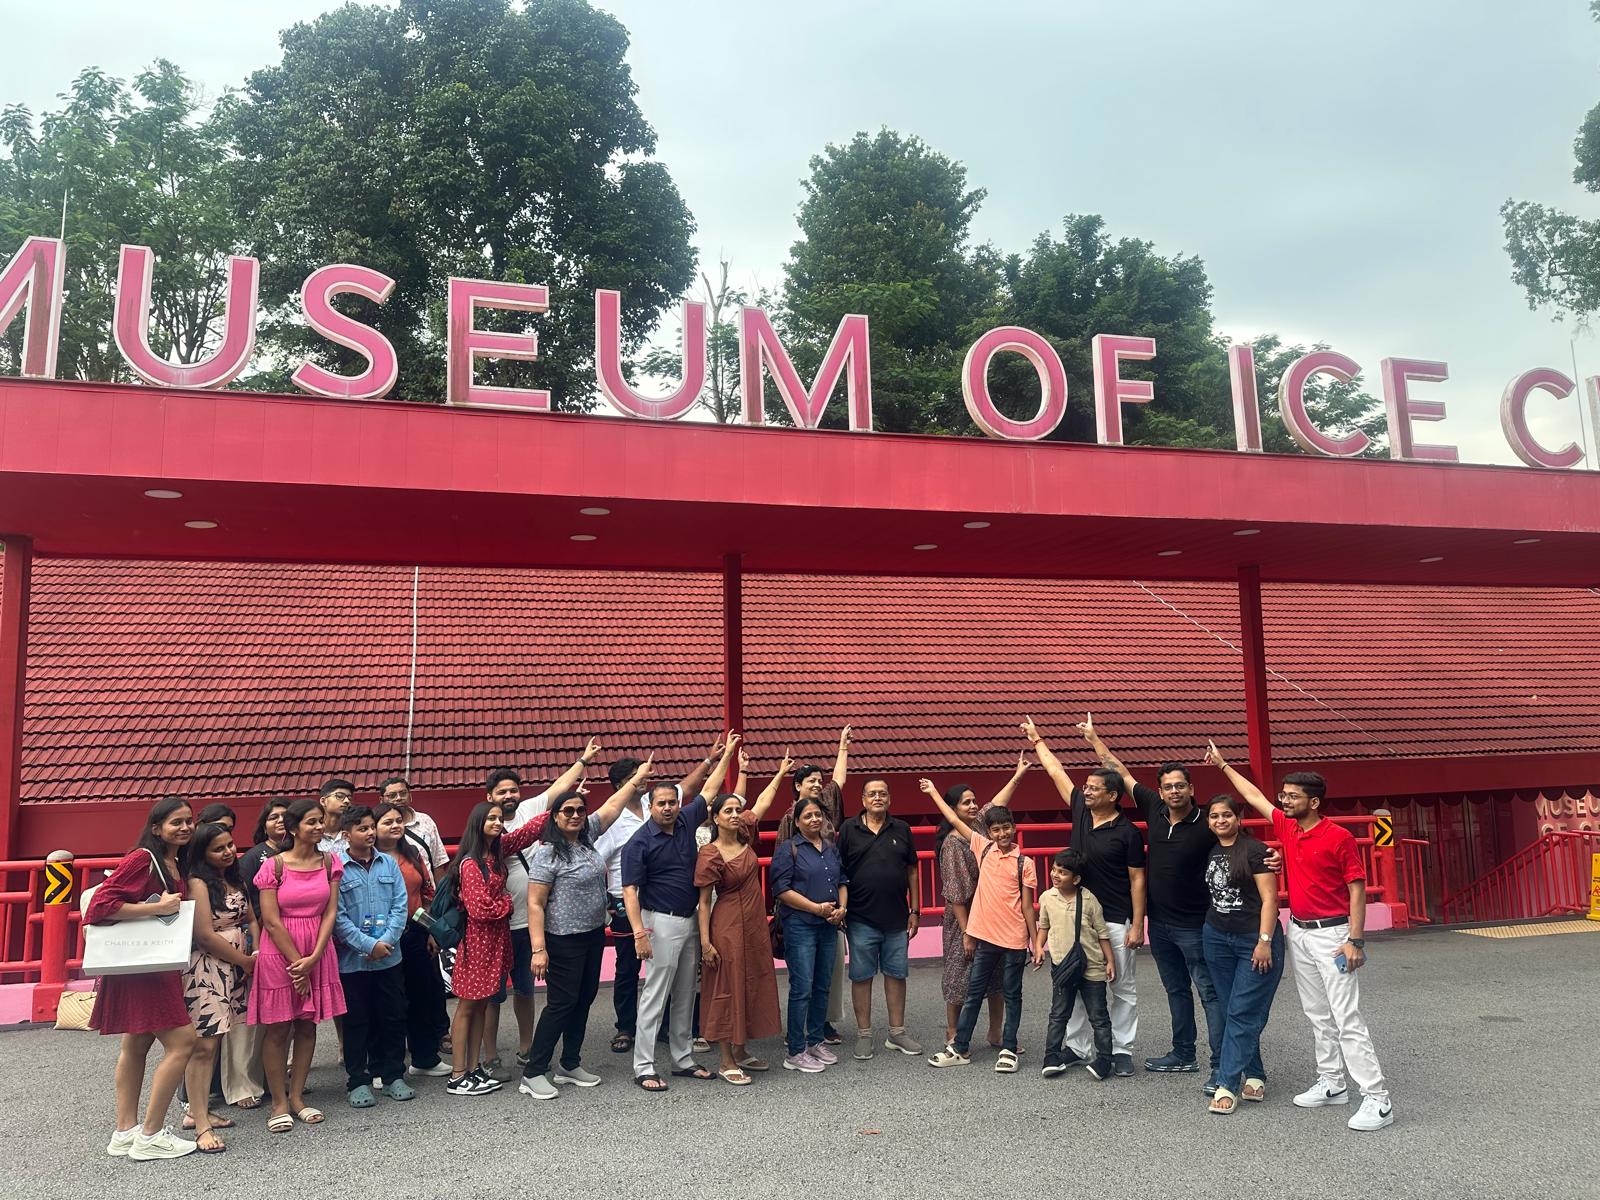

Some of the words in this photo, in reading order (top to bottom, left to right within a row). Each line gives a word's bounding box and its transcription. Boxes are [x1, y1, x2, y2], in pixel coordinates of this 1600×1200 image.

[962, 325, 1157, 446] OF
[1229, 344, 1460, 464] ICE
[1500, 367, 1600, 471] C
